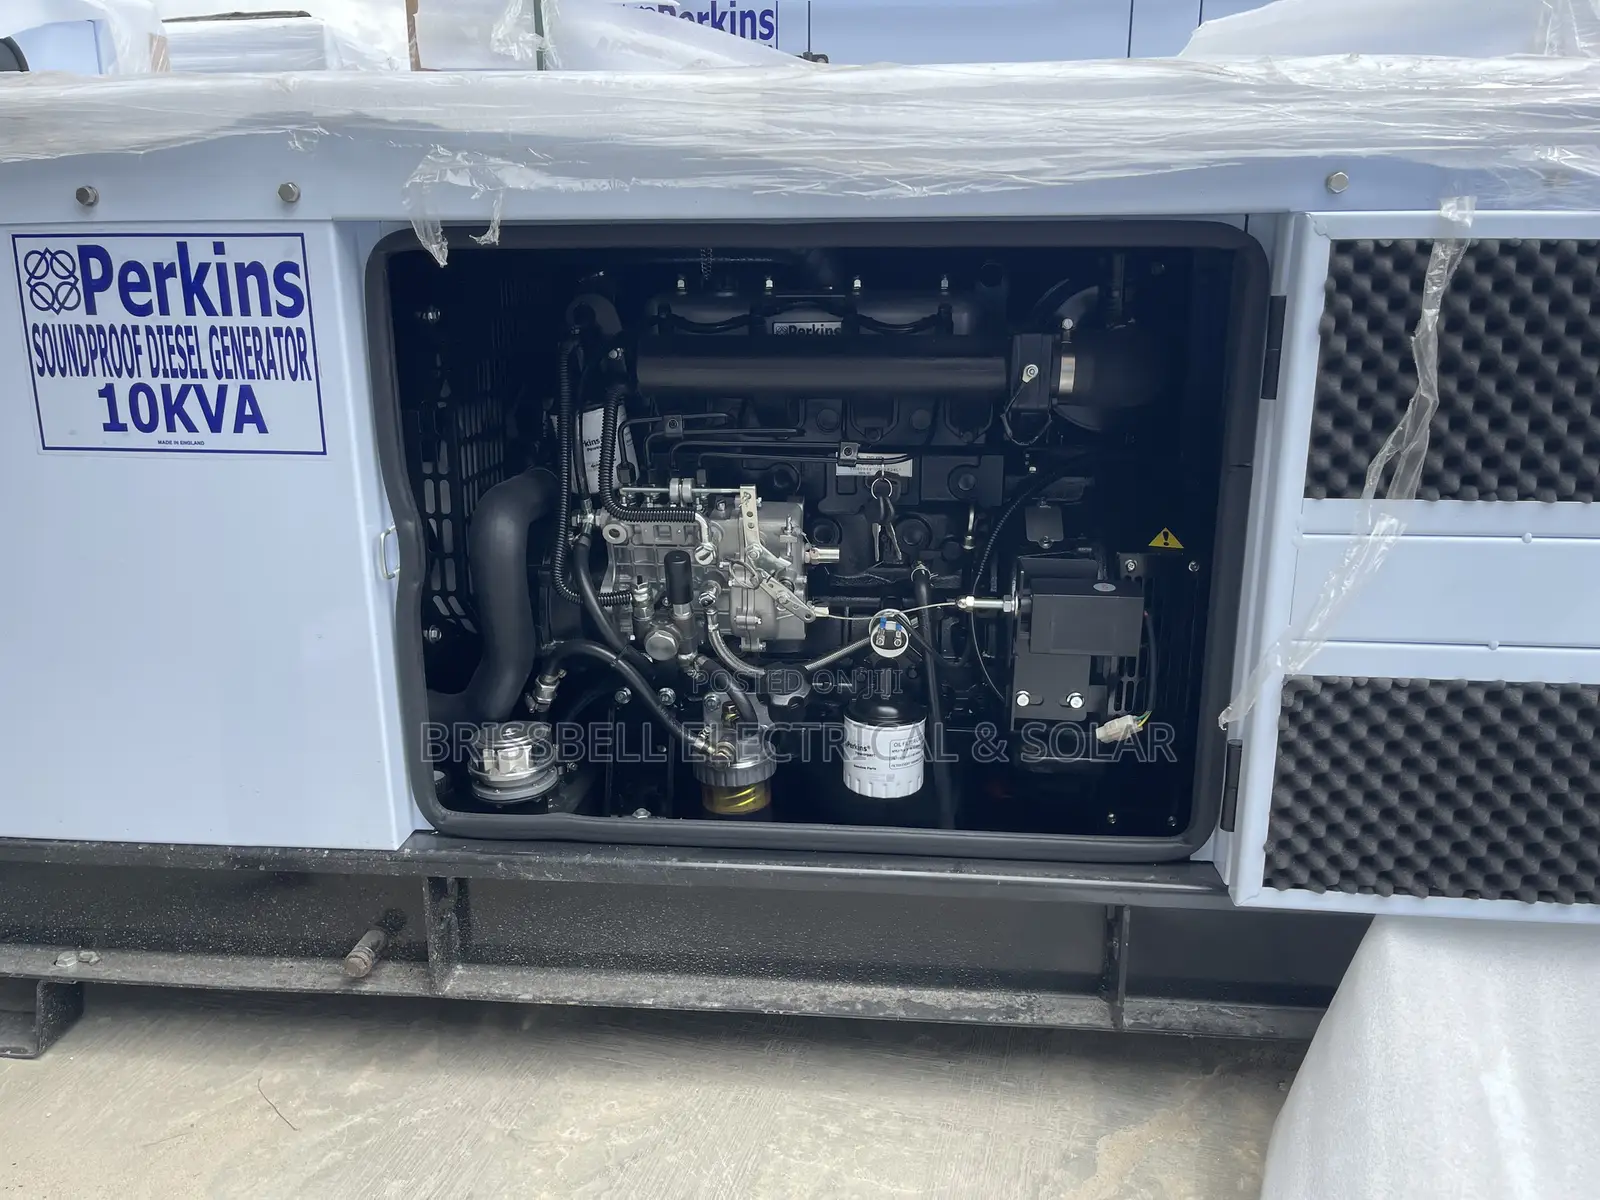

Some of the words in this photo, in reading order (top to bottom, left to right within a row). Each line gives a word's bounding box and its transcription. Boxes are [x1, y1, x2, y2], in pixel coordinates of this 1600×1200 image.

[77, 241, 305, 318] Perkins
[31, 322, 142, 378] SOUNDPROOF
[145, 323, 208, 380] DIESEL
[208, 324, 313, 381] GENERATOR
[97, 382, 269, 434] 10KVA
